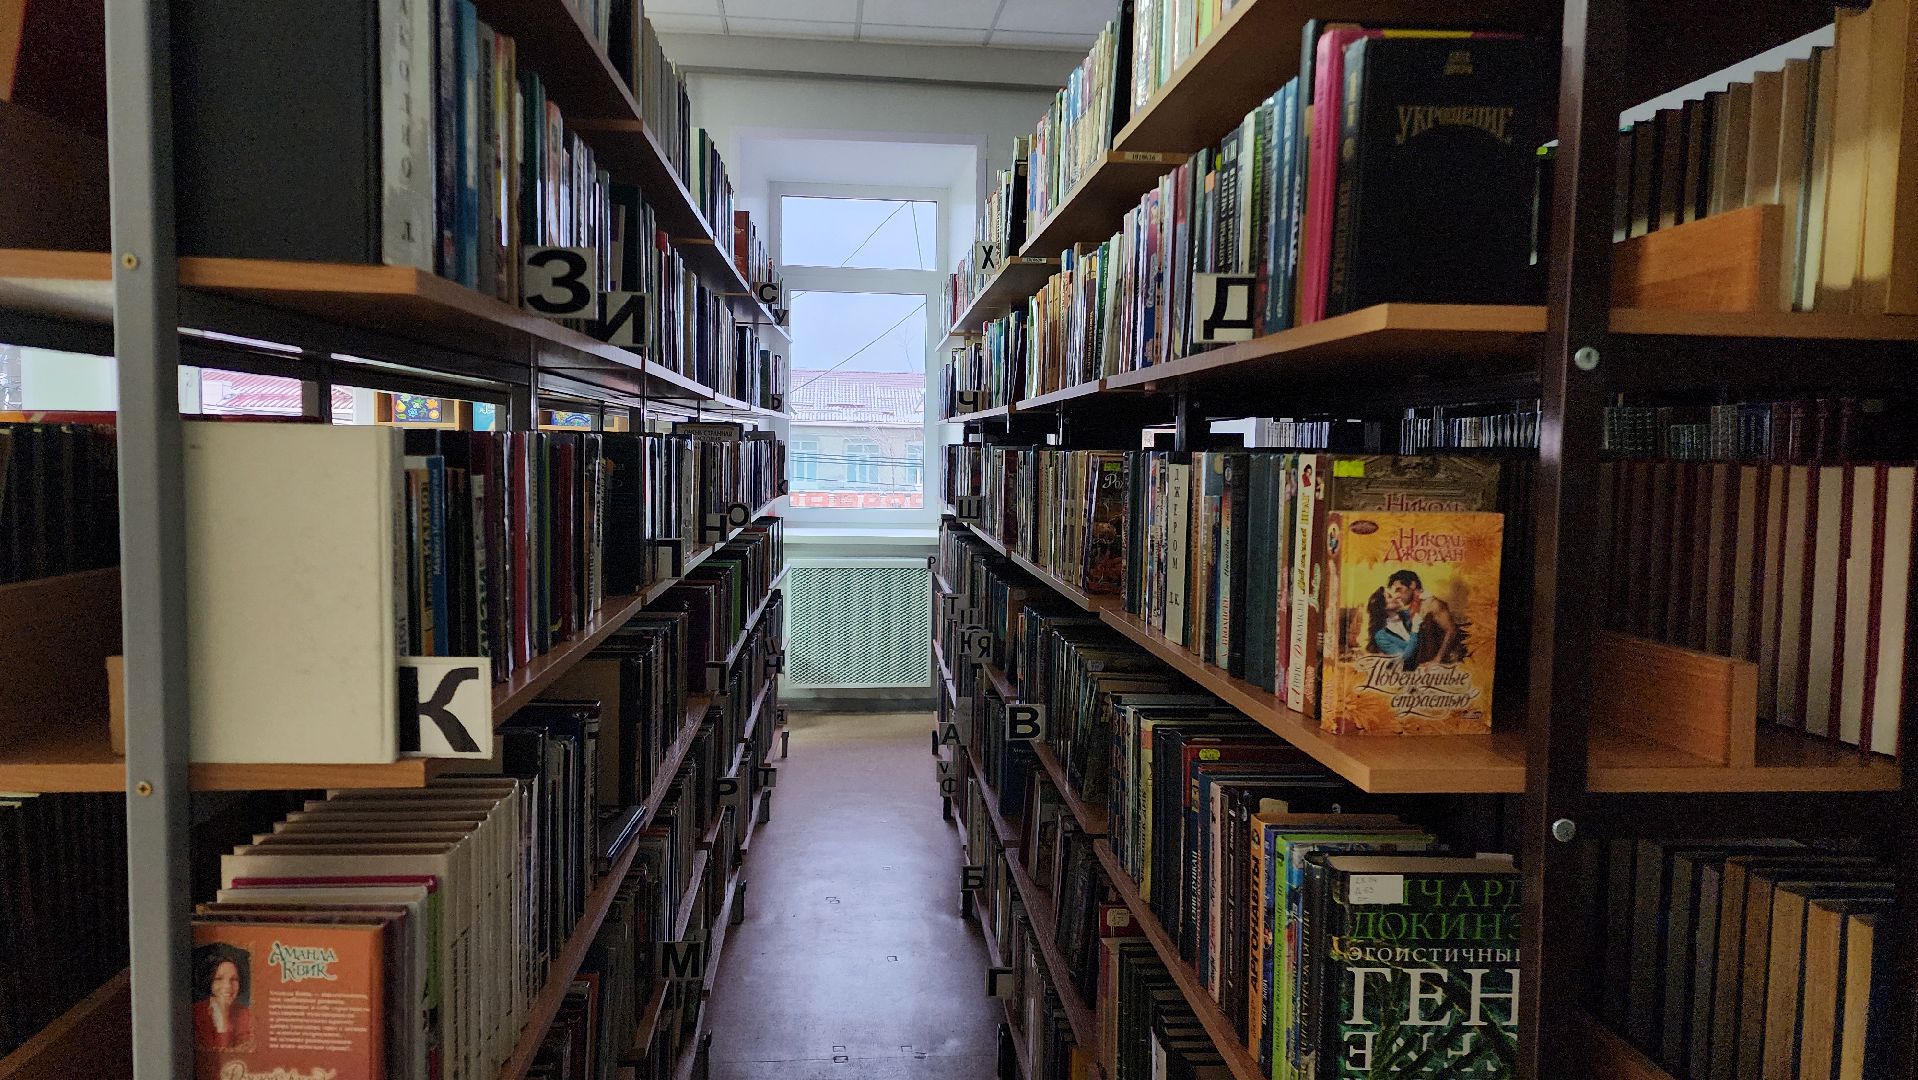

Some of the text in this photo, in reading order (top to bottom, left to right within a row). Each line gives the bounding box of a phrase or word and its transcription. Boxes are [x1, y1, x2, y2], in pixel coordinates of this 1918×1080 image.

[982, 245, 994, 269] Х
[527, 249, 591, 314] З
[758, 283, 777, 303] С
[599, 294, 645, 345] И
[1203, 278, 1256, 340] Д
[958, 392, 978, 411] Ч
[727, 503, 750, 526] О
[959, 498, 982, 519] Ш
[1172, 468, 1181, 570] ДЖЕРОМ
[1397, 528, 1466, 547] НИКОЛЬ
[1384, 540, 1465, 563] ДЖОРДАН
[947, 597, 958, 615] Т
[978, 636, 991, 658] Я
[1359, 660, 1471, 692] Повенчанные
[400, 666, 482, 753] К
[1390, 691, 1474, 716] страстью
[1011, 707, 1041, 737] В
[942, 724, 961, 744] А
[942, 777, 957, 794] Ф
[962, 867, 985, 890] Б
[1250, 855, 1260, 993] АРГОНАВТЫ
[269, 941, 336, 963] АМАНДА
[662, 943, 700, 977] М
[283, 962, 333, 980] КВИК
[988, 969, 1013, 996] Г
[1343, 967, 1520, 1027] ГЕН
